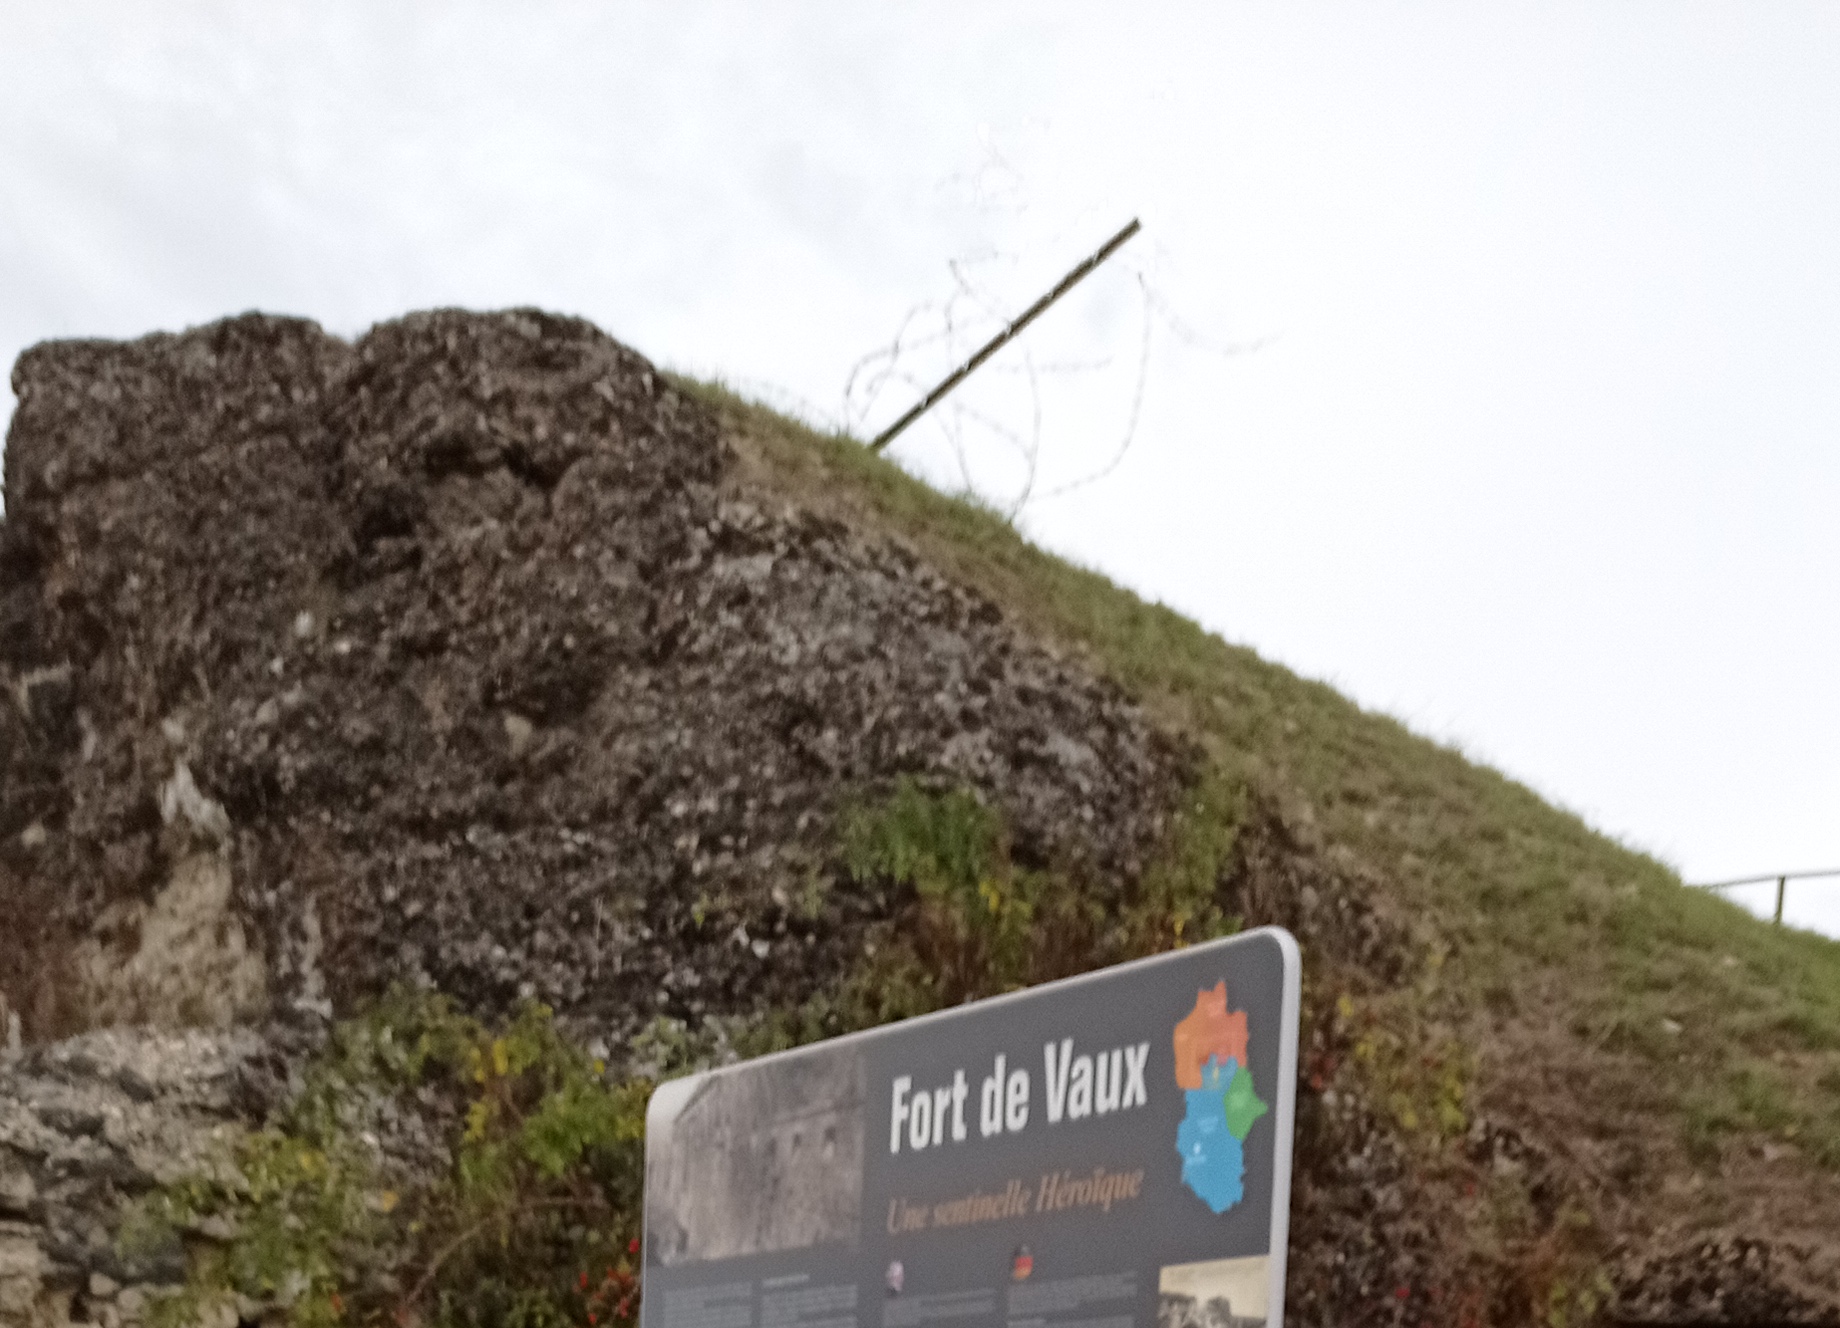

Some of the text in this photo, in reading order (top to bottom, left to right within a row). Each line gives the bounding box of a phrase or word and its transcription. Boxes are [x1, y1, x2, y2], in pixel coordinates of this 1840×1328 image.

[890, 1037, 1151, 1154] Fort de Vaux
[886, 1199, 925, 1235] Une
[932, 1179, 1032, 1229] sentinelle
